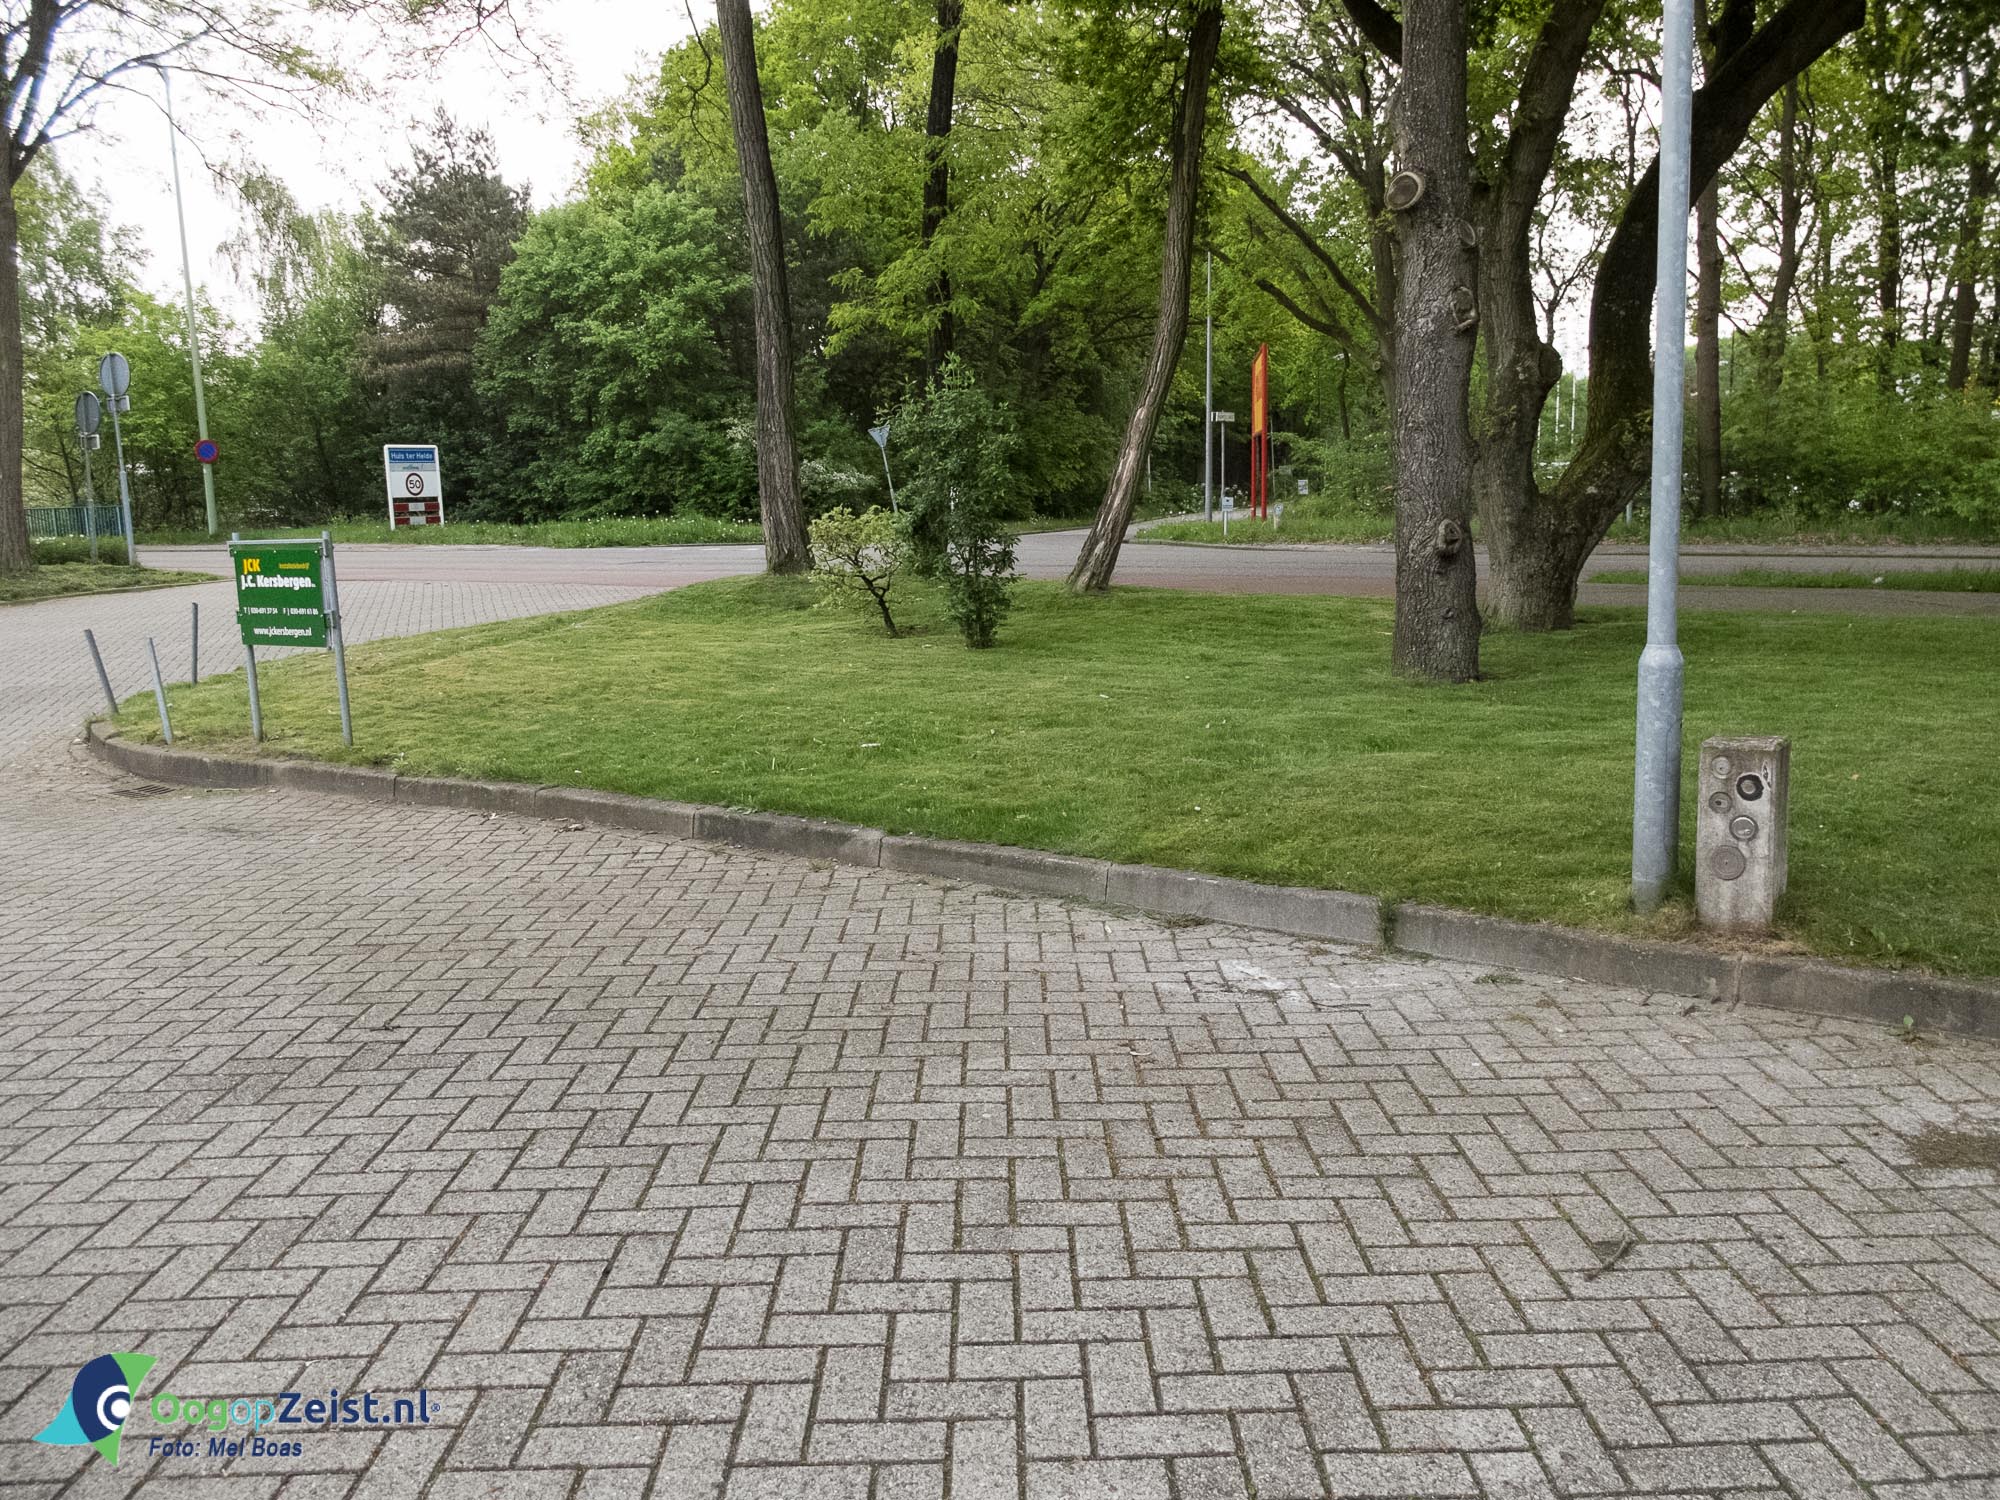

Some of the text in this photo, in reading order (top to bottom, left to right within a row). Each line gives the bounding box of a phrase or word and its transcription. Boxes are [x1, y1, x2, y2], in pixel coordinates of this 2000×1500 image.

[391, 452, 404, 460] Huis
[416, 452, 432, 460] Heide
[409, 479, 421, 489] 50
[243, 559, 261, 575] JCK
[241, 575, 256, 590] J.C.
